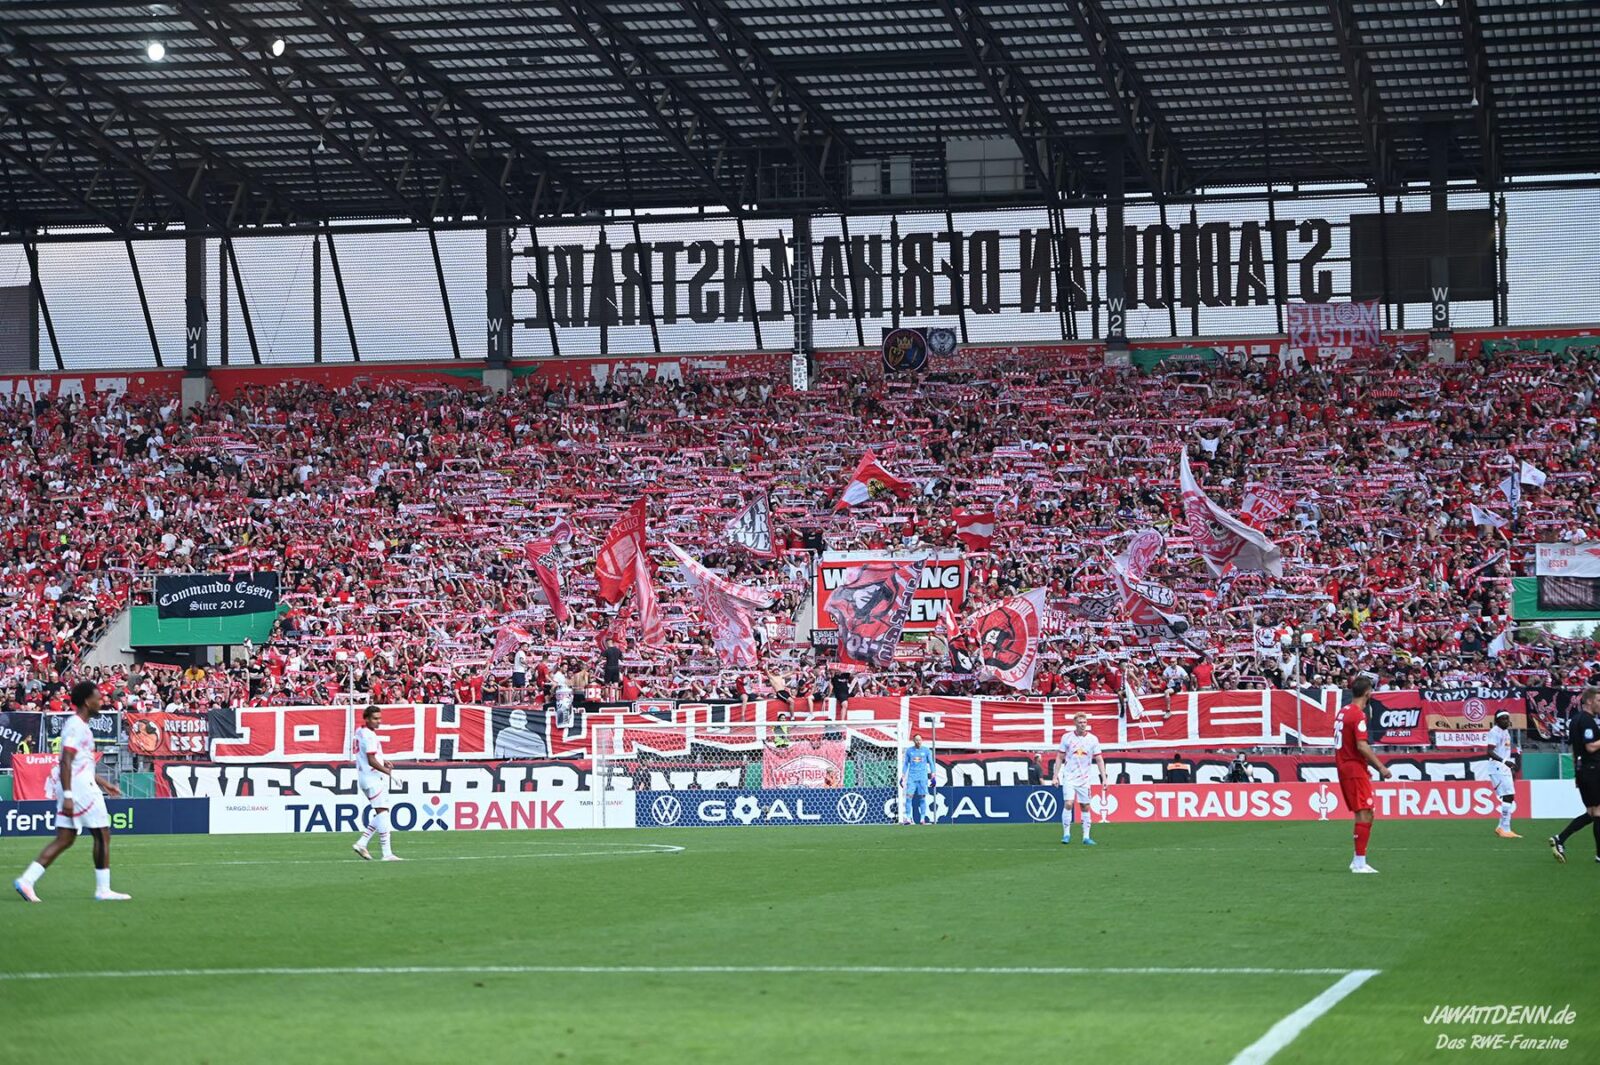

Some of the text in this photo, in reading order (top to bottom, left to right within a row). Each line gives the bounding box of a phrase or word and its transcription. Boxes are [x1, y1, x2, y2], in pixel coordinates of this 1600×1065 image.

[1432, 287, 1448, 301] W
[1108, 298, 1124, 311] W
[1434, 304, 1447, 321] 3
[488, 318, 503, 332] W
[1110, 315, 1122, 331] 2
[187, 327, 201, 341] W
[1290, 325, 1379, 347] KASTEN
[491, 335, 498, 350] 1
[189, 343, 199, 360] 1
[1548, 559, 1568, 568] ESSEN
[159, 581, 273, 607] Commando Essen
[189, 597, 246, 611] Since 2012
[1380, 710, 1420, 728] CREW
[1443, 733, 1453, 742] LA
[1455, 733, 1480, 742] BANDA
[1135, 788, 1293, 818] STRAUSS
[455, 800, 565, 830] BANK
